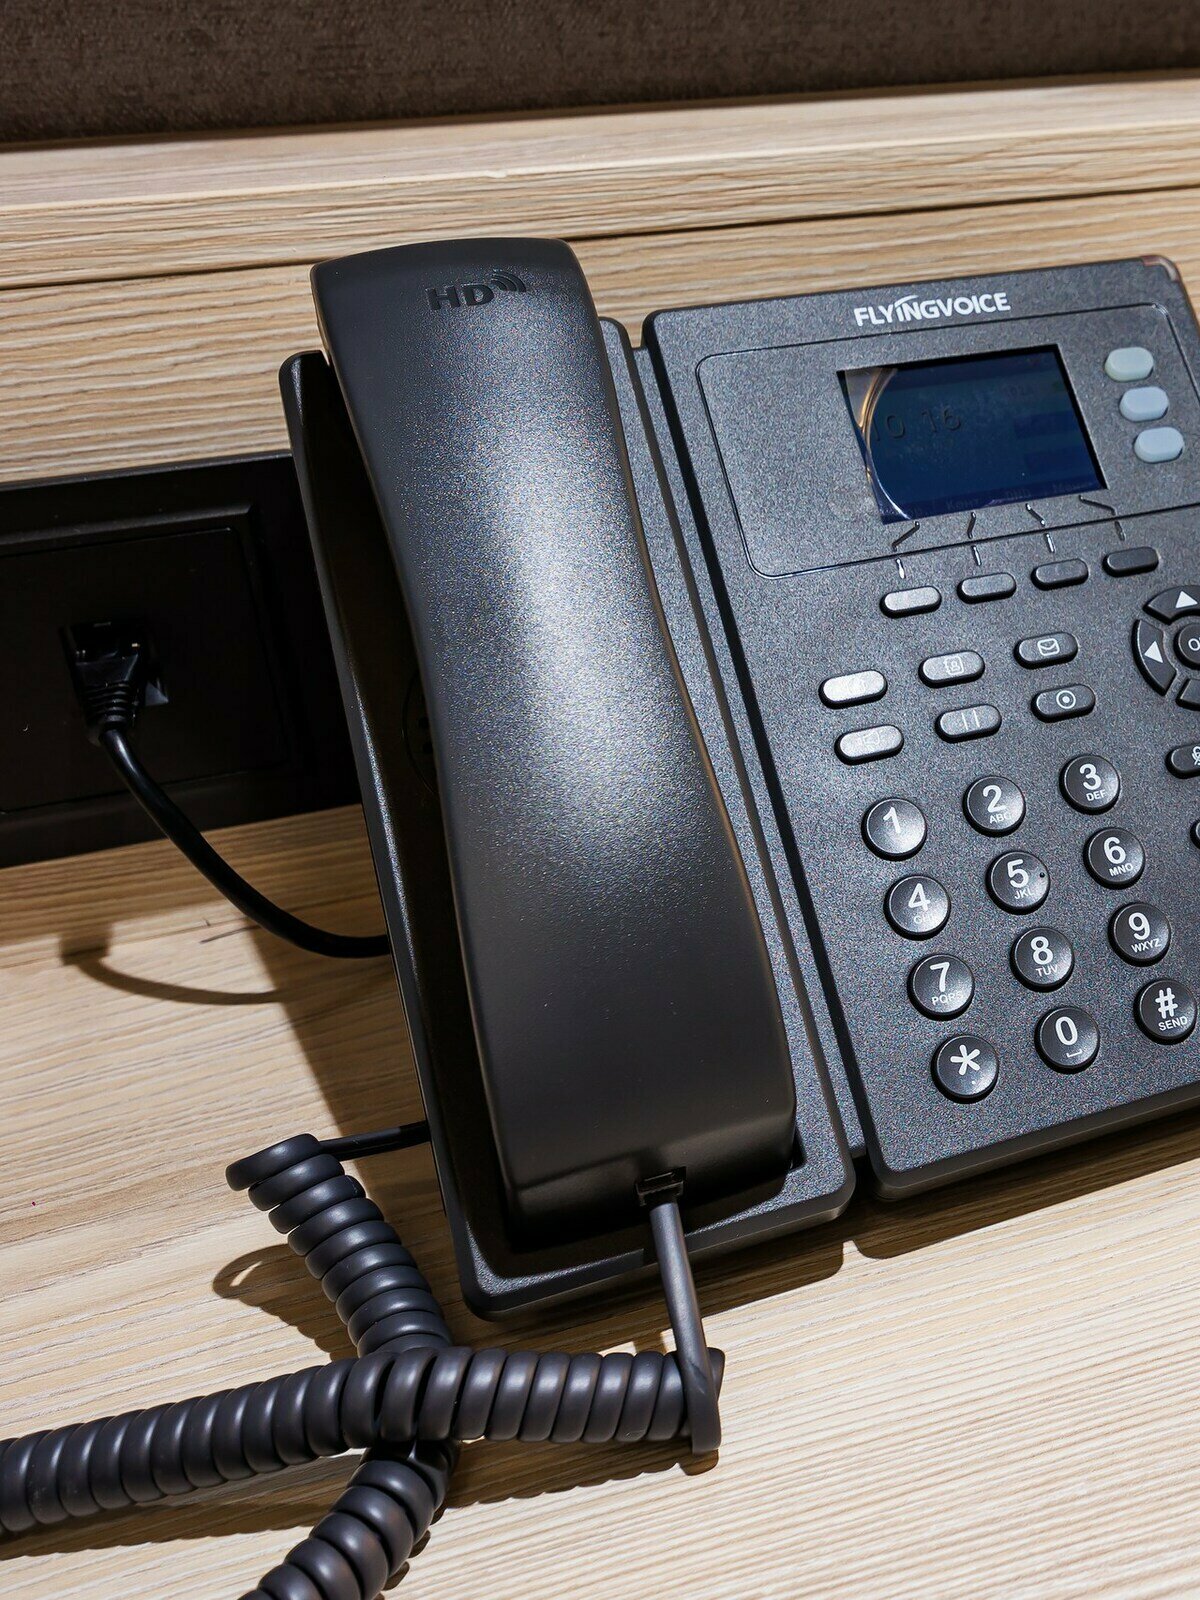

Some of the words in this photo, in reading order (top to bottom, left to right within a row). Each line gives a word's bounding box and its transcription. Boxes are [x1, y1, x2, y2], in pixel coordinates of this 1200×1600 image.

[425, 283, 495, 310] HD
[854, 293, 1011, 326] FLYINGVOICE
[1079, 763, 1102, 791] 3
[982, 785, 1007, 813] 2
[1086, 789, 1107, 802] DEF
[883, 806, 902, 834] 1
[989, 812, 1012, 824] ABC
[1103, 836, 1126, 865] 6
[1007, 858, 1029, 888] 5
[1109, 862, 1134, 876] MNO
[908, 883, 930, 911] 4
[1014, 886, 1034, 900] JKL
[1128, 912, 1151, 940] 9
[1030, 936, 1054, 965] 8
[1131, 938, 1162, 954] WXYZ
[930, 961, 950, 992] 7
[1035, 963, 1059, 977] TUV
[1055, 1016, 1079, 1046] 0
[1158, 1015, 1189, 1032] SEND
